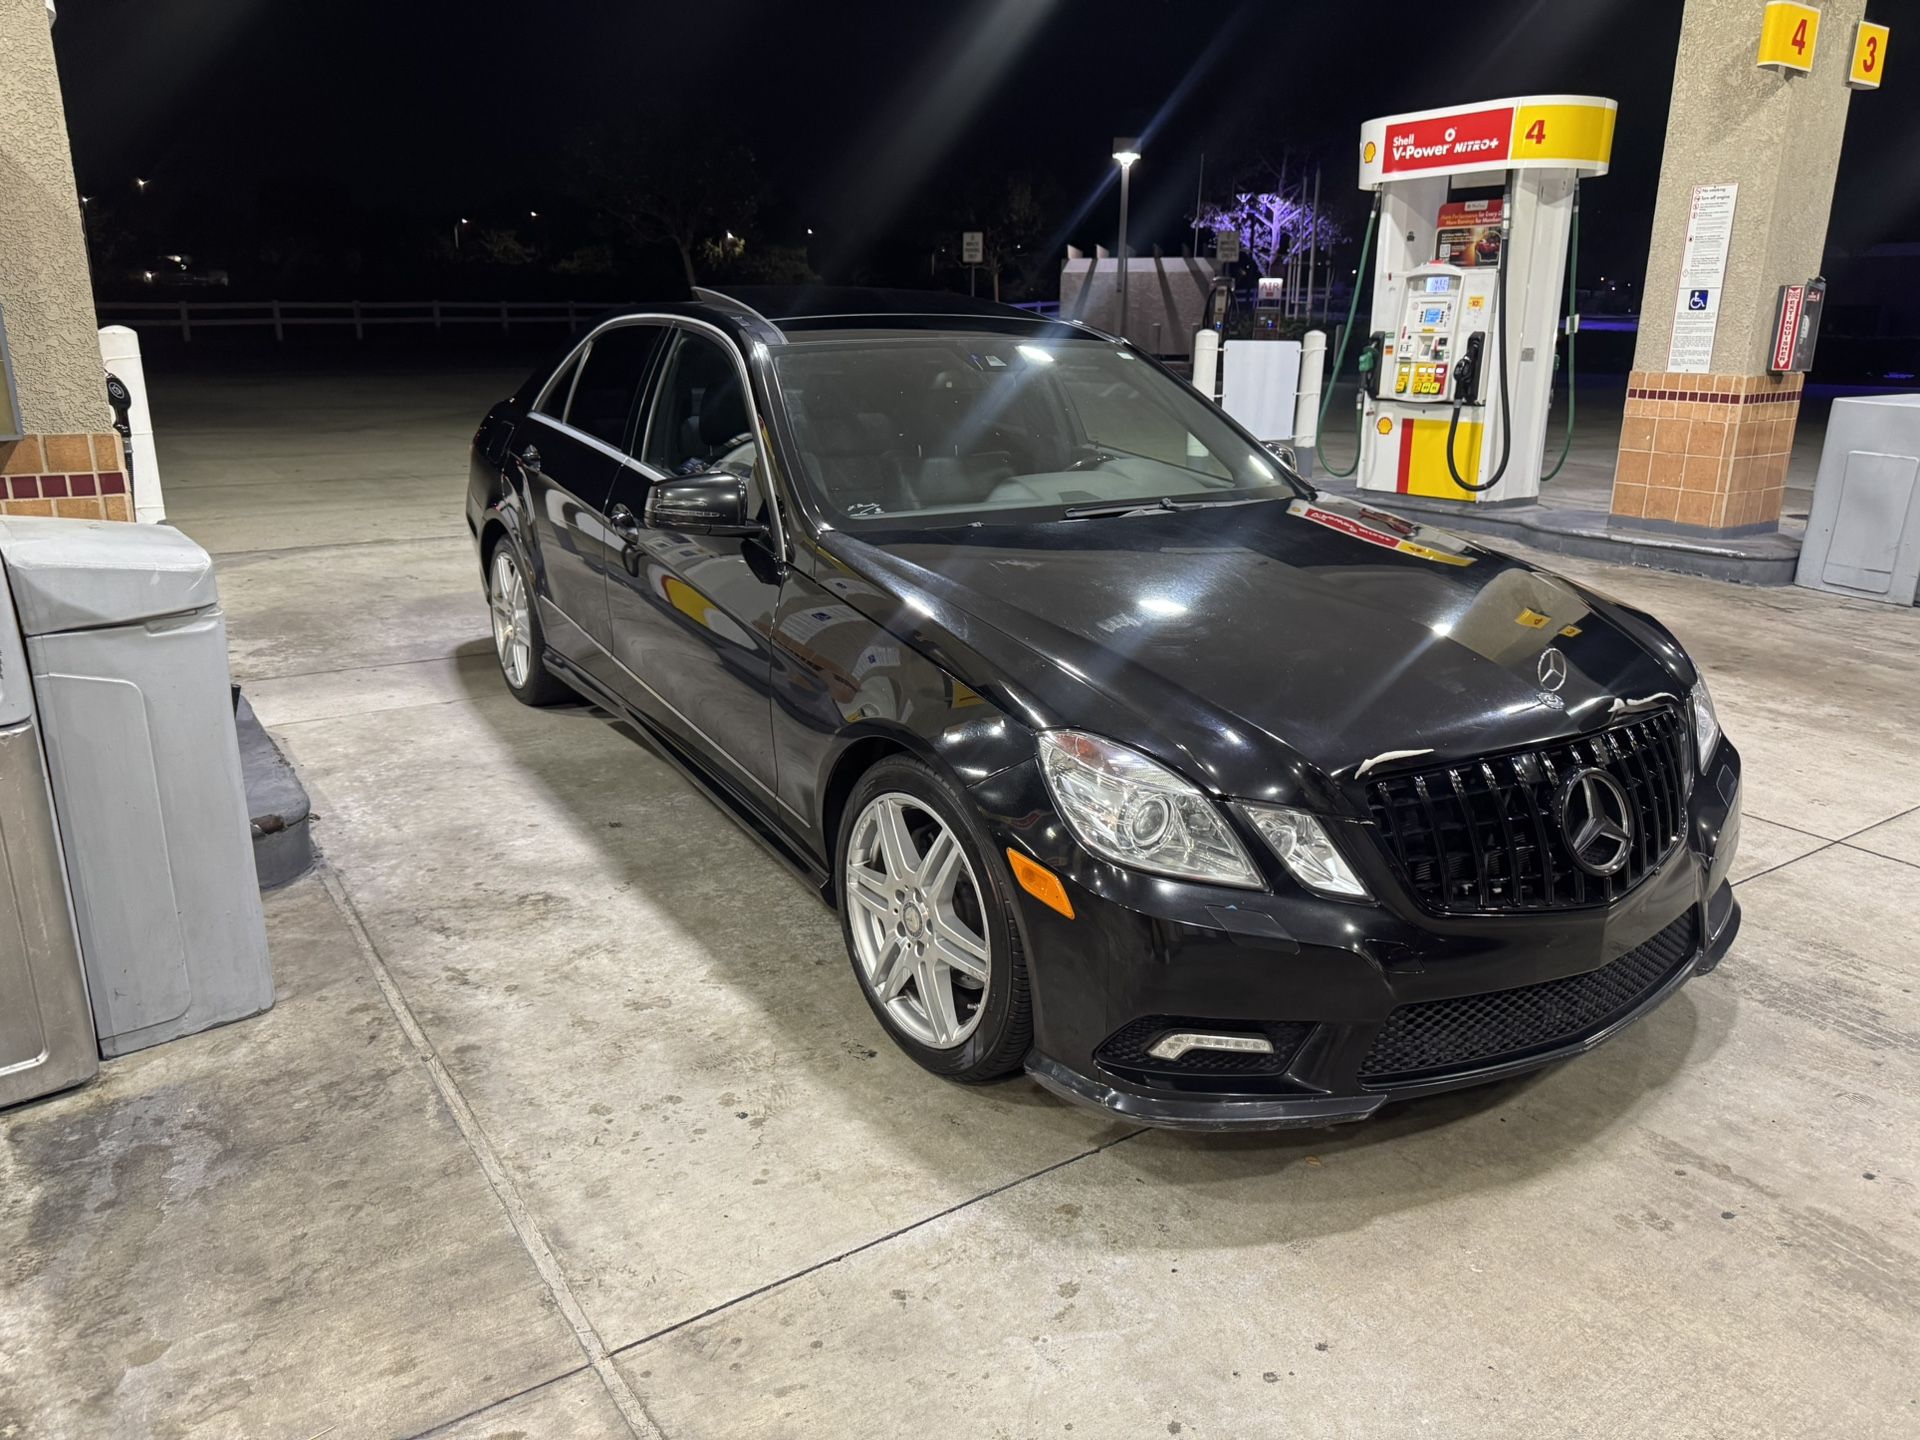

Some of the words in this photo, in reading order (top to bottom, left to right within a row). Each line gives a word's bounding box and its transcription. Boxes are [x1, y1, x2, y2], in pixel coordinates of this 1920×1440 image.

[1791, 18, 1808, 56] 4
[1862, 36, 1878, 73] 3
[1393, 133, 1415, 147] Shell
[1525, 119, 1546, 145] 4
[1392, 144, 1450, 161] V-Power
[1260, 281, 1281, 291] AIR
[1779, 299, 1796, 362] EXTINGUISHER
